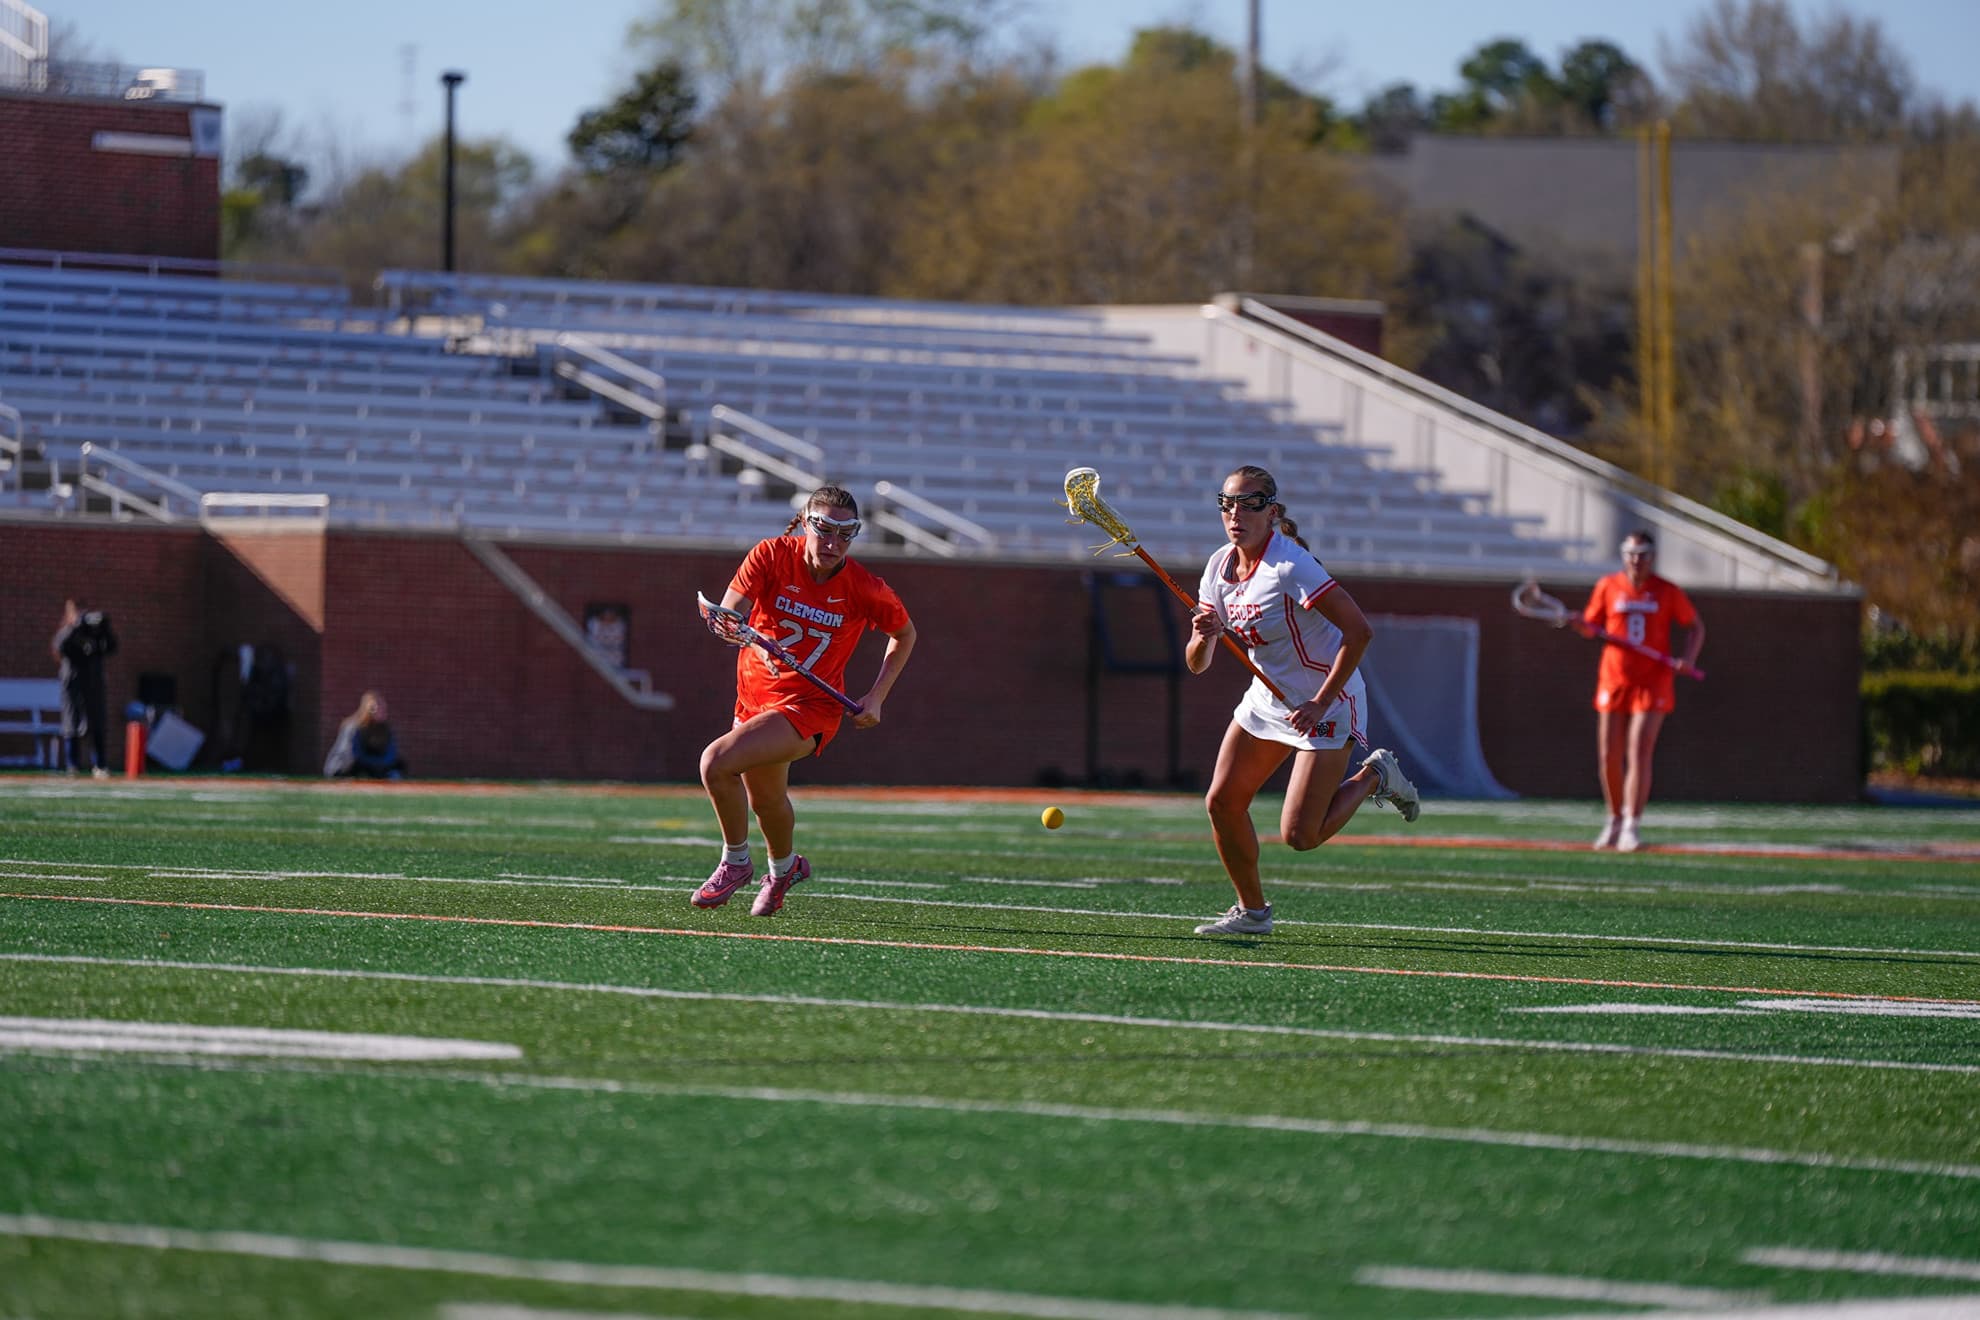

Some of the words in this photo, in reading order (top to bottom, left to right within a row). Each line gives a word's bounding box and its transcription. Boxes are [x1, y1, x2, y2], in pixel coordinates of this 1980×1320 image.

[775, 595, 844, 628] CLEMSON
[1226, 603, 1263, 621] ERCER
[779, 618, 832, 670] 27
